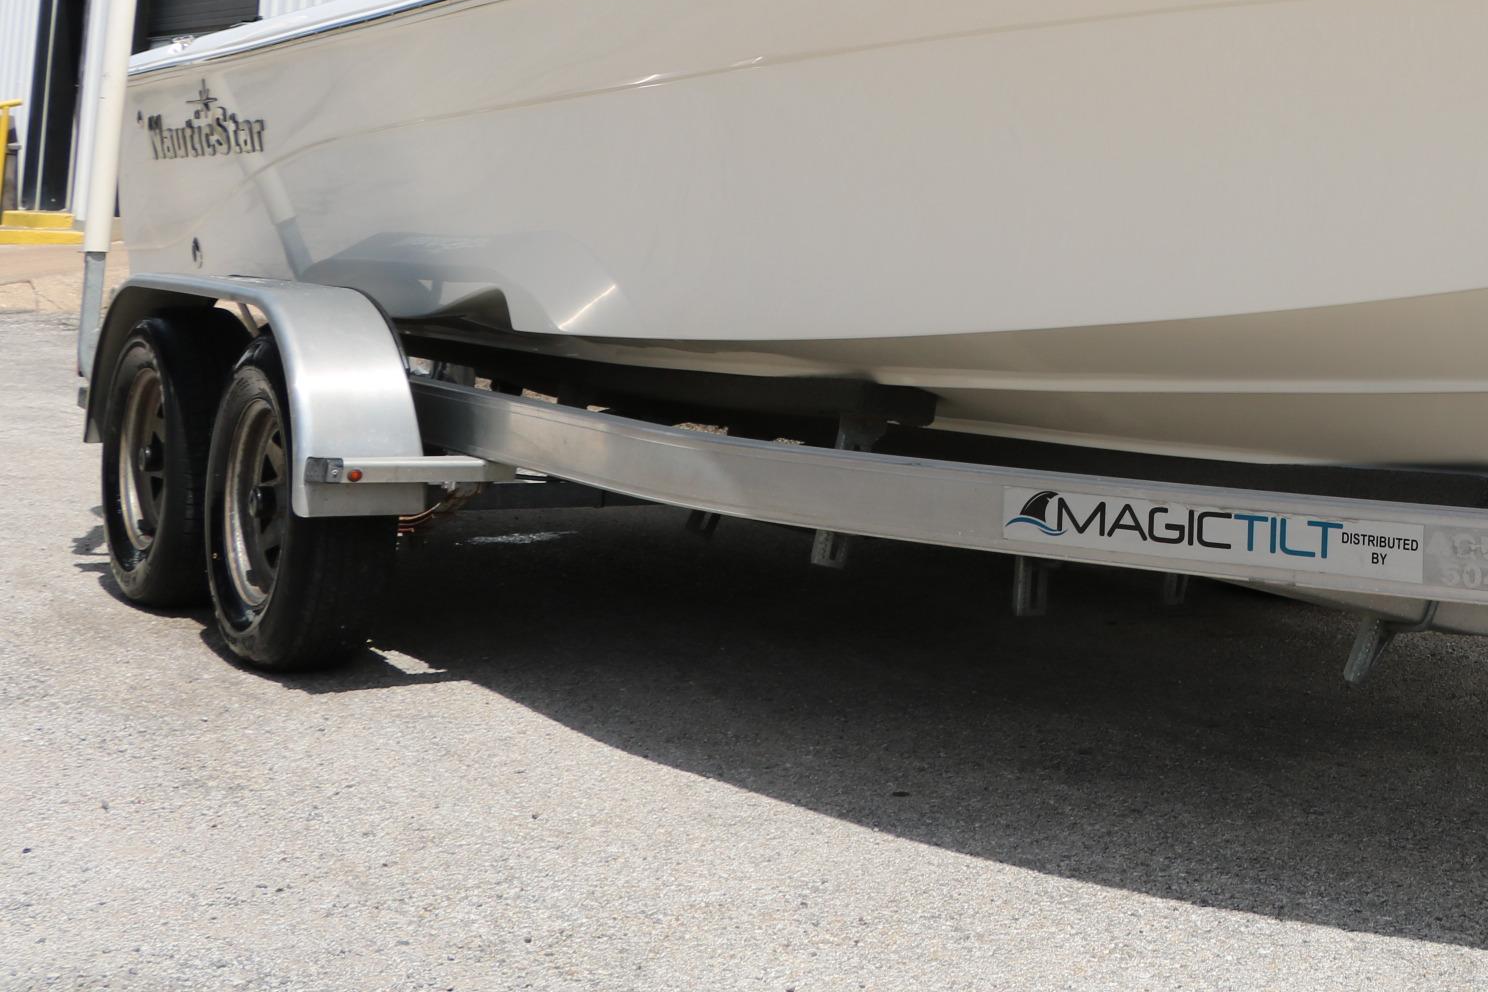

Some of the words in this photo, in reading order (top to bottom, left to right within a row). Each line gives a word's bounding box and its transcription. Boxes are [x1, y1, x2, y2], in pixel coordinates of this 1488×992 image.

[1056, 496, 1344, 559] MAGICTILT
[1341, 531, 1419, 552] DISTRIBUTED
[1371, 552, 1388, 565] BY
